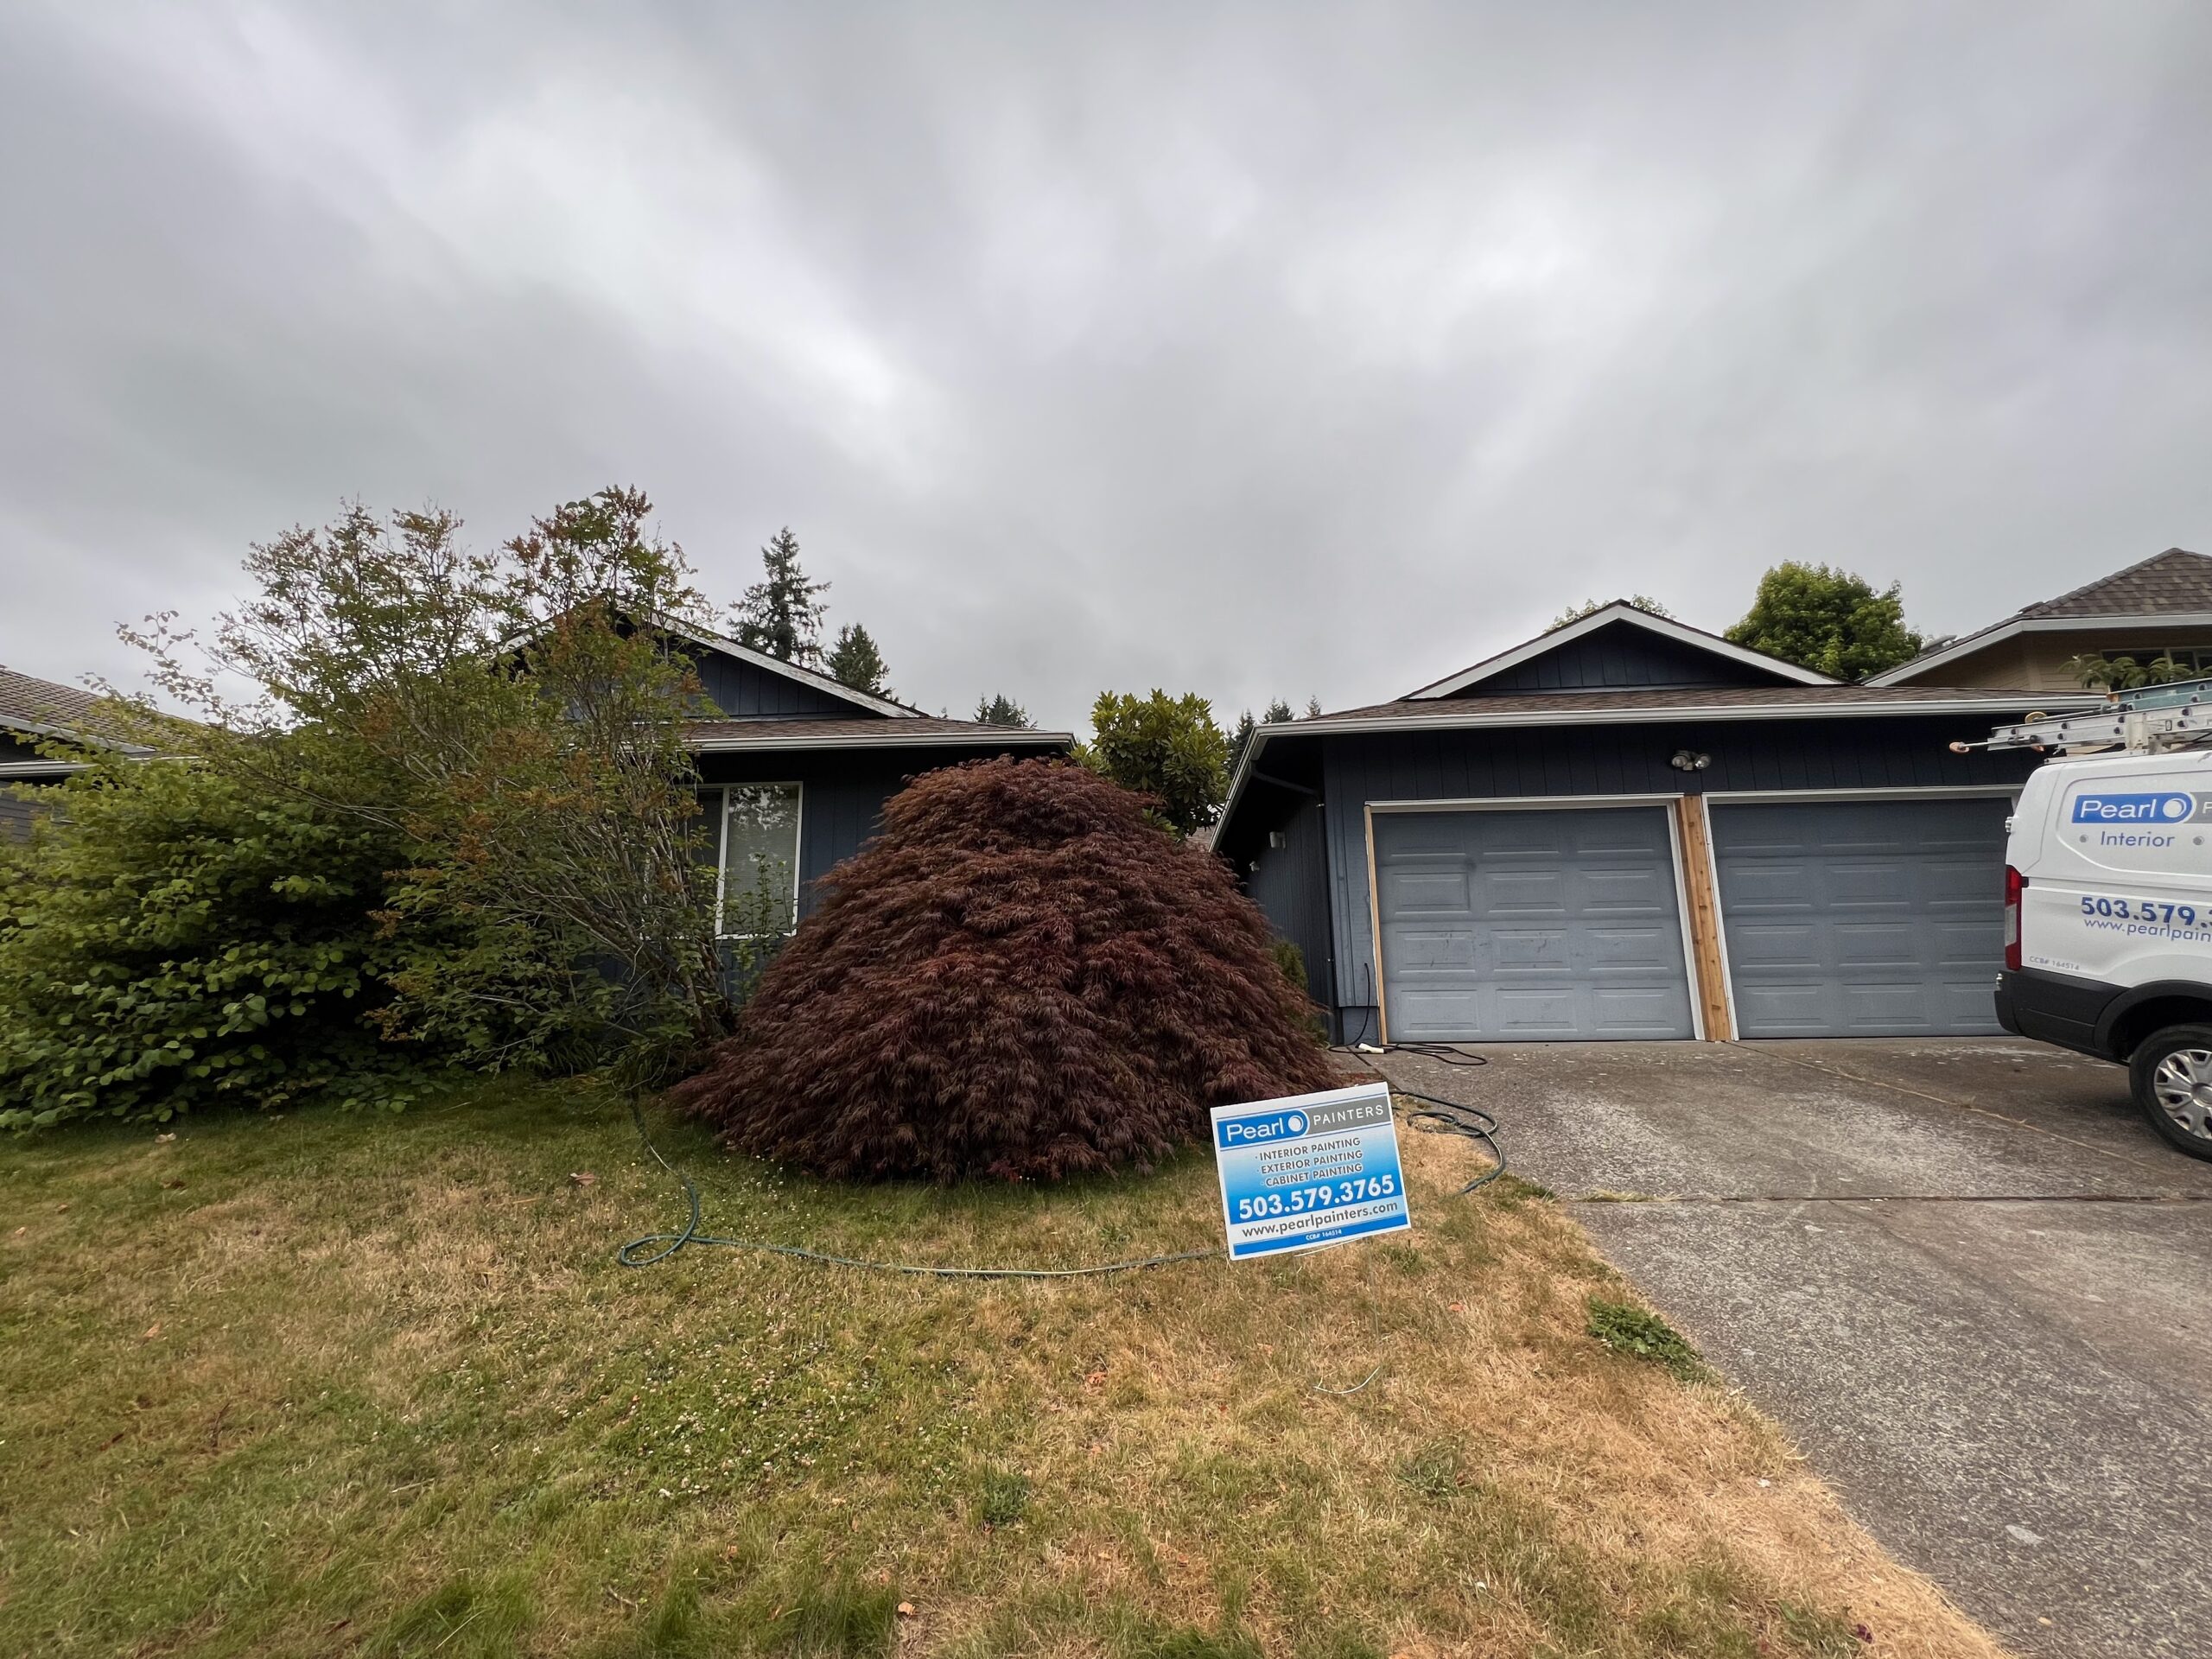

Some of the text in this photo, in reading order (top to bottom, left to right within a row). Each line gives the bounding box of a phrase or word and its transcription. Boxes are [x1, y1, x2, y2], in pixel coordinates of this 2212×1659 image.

[2080, 798, 2157, 818] Pearl
[2101, 831, 2176, 847] Interior
[2081, 896, 2212, 928] 503.579.
[2030, 956, 2080, 970] CCB# 164514
[1226, 1104, 1384, 1142] Pearl PAINTERS
[1260, 1137, 1361, 1160] INTERIOR PAINTING
[1261, 1150, 1363, 1174] EXTERIOR PAINTING
[1266, 1163, 1363, 1186] CABINET PAINTING
[1239, 1174, 1395, 1219] 503.579.3765
[1242, 1201, 1398, 1237] www.pearlpainters.com
